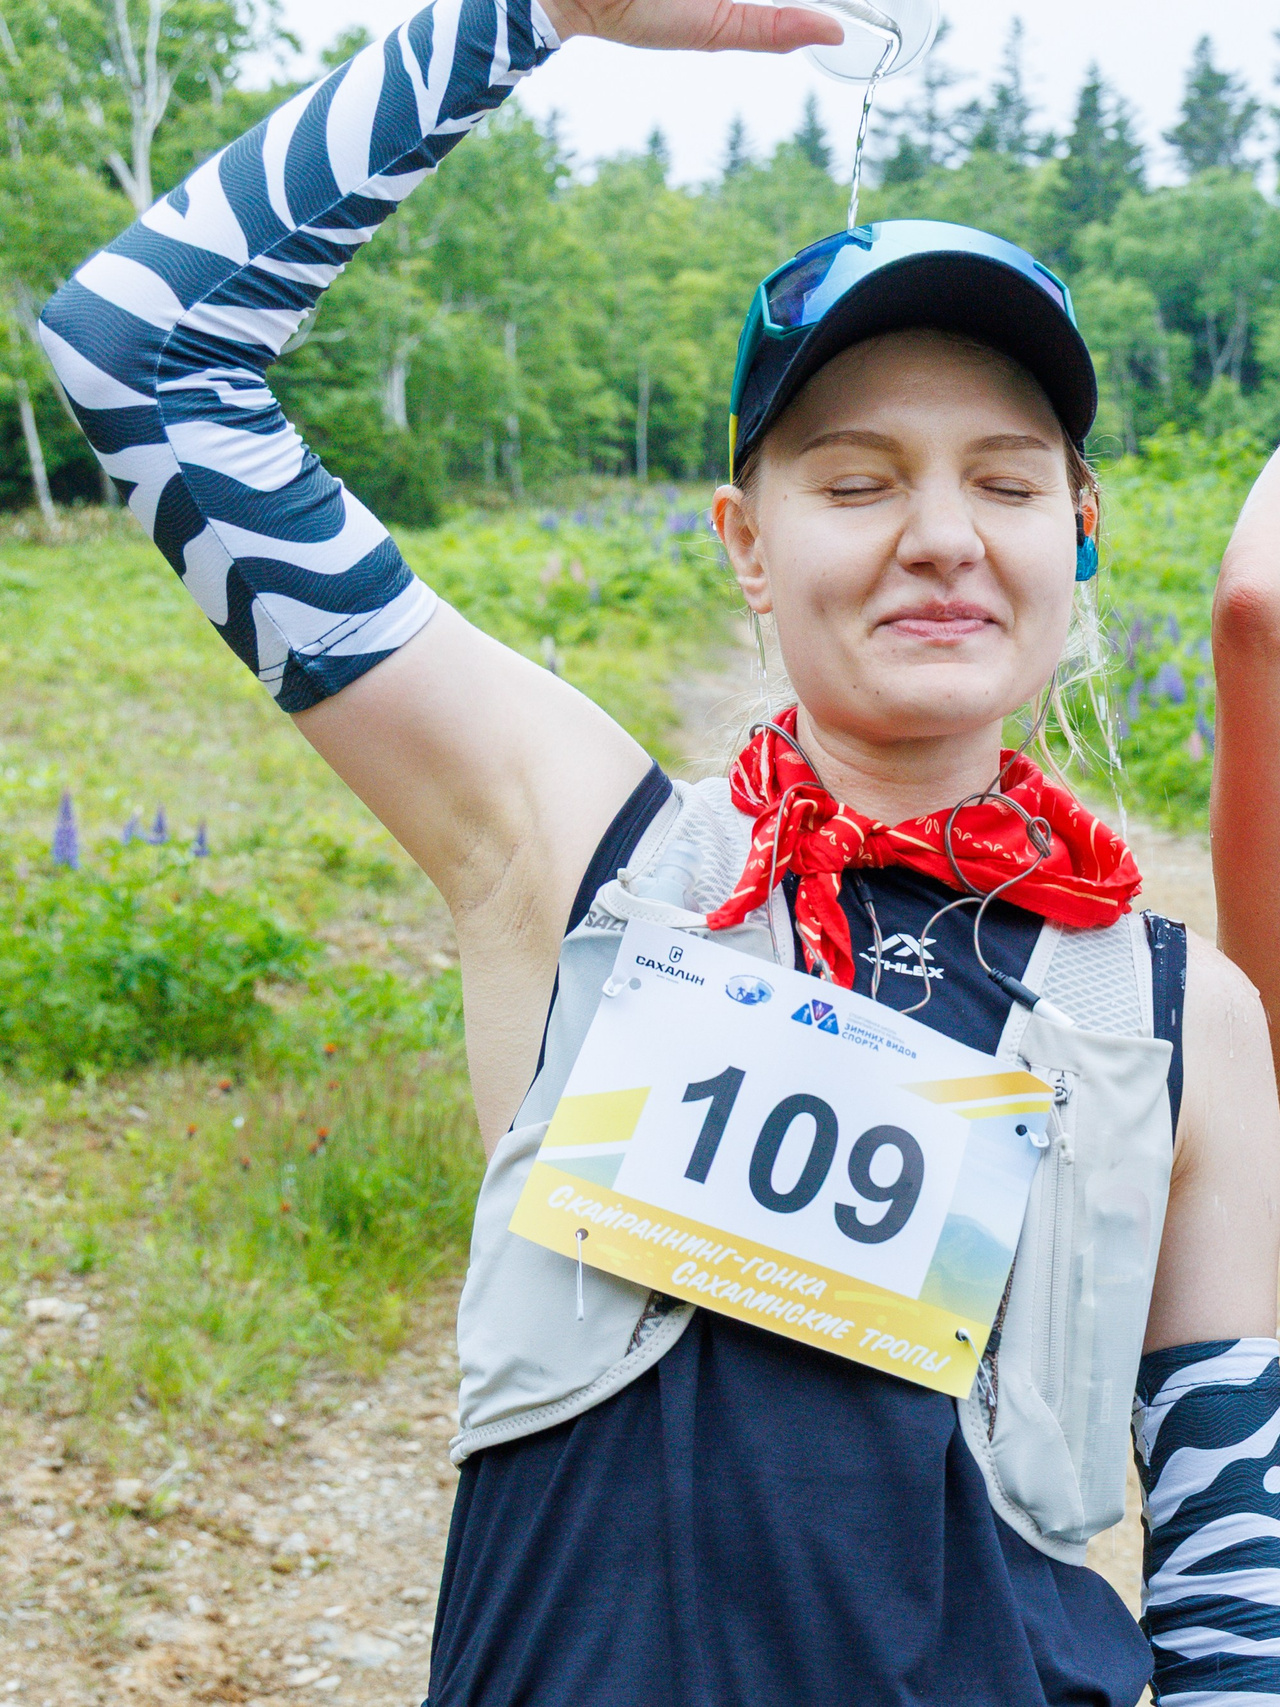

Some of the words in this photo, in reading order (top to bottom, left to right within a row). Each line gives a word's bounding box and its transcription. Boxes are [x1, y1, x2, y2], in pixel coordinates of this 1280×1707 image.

[635, 955, 705, 986] САХАЛИН
[841, 1031, 880, 1052] СПОРТА
[844, 1022, 884, 1044] ЗИМНИХ
[886, 1040, 917, 1059] ВИДОВ
[681, 1065, 925, 1244] 109
